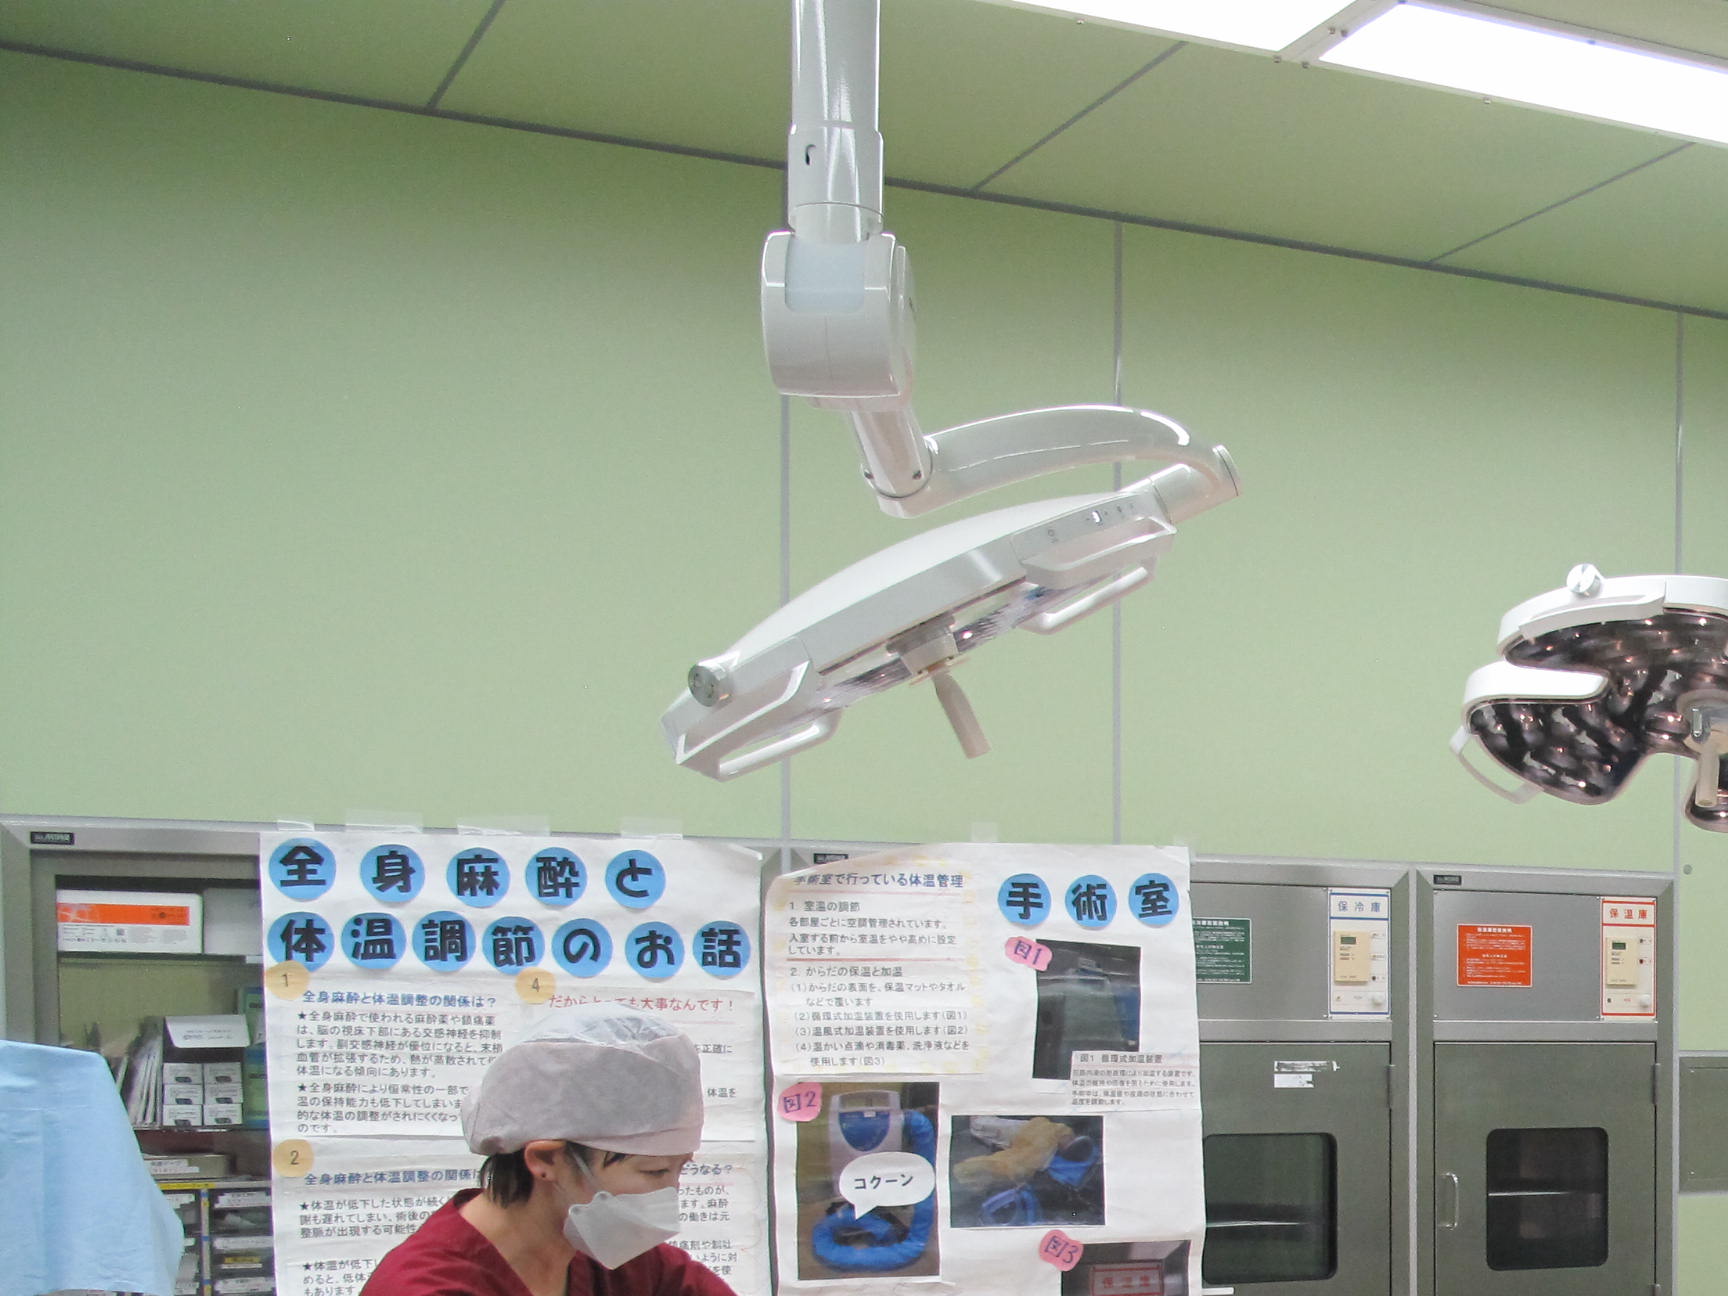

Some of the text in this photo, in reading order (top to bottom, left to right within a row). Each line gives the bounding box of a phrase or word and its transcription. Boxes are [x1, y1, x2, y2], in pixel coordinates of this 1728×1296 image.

[278, 846, 655, 898] 全身麻酔と
[1006, 880, 1174, 921] 手術室
[280, 915, 744, 969] 体温調節のお話
[531, 977, 541, 993] 4
[706, 1087, 737, 1099] 体温を
[290, 1150, 299, 1165] 2
[854, 1173, 913, 1189] コクーン
